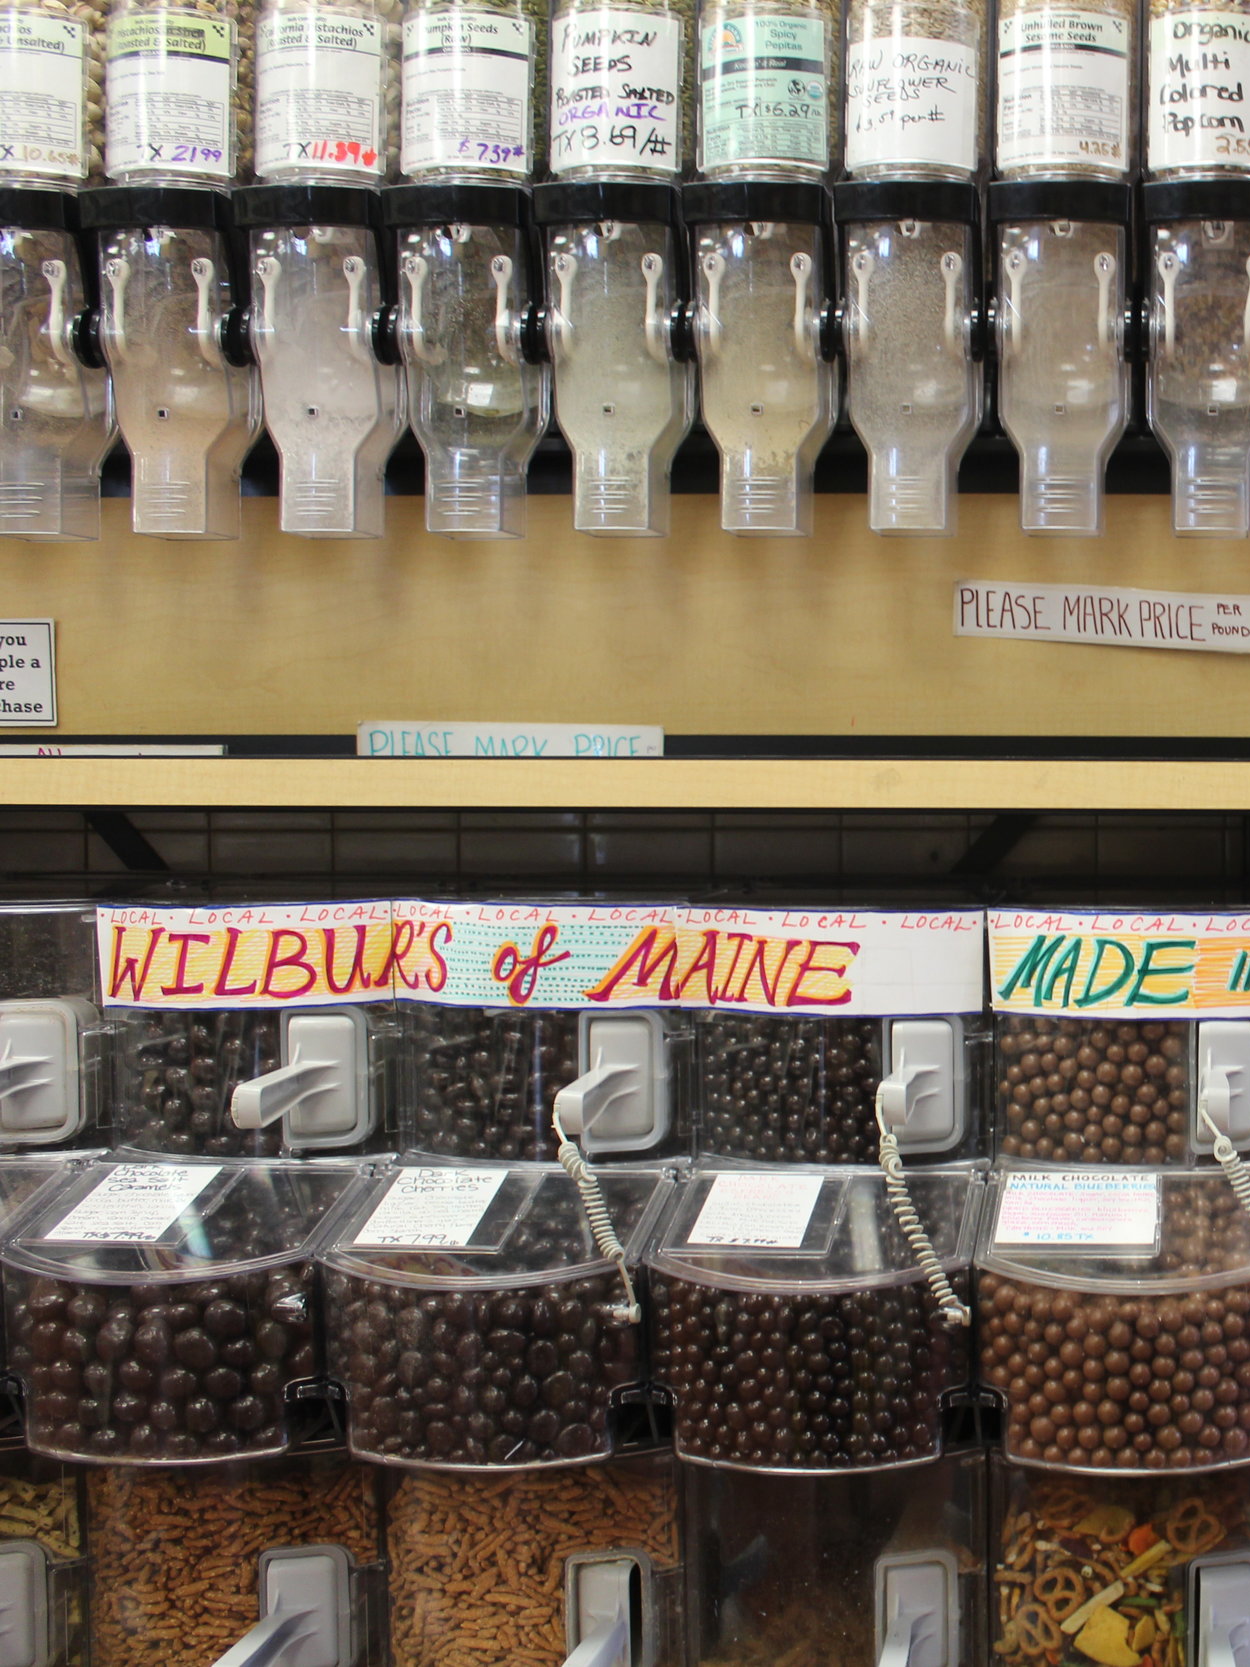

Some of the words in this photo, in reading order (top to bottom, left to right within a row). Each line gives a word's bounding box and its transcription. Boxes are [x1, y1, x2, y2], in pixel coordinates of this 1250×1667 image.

[115, 26, 160, 38] istachios
[309, 23, 364, 38] istachios
[466, 22, 499, 35] Seeds
[769, 28, 798, 41] Spicy
[1067, 20, 1104, 33] Brown
[561, 22, 658, 52] PUMPKIN
[1067, 31, 1098, 43] Seeds
[567, 55, 633, 77] SEEDS
[892, 52, 977, 79] ORGANIC
[1169, 51, 1231, 79] Multi
[558, 102, 668, 126] ORGANIC
[959, 587, 1052, 631] PLEASE
[1062, 594, 1133, 638] MARK
[1138, 599, 1208, 642] PRICE
[1216, 602, 1243, 617] PER
[30, 656, 42, 669] a
[368, 730, 455, 757] PLEASE
[110, 910, 163, 926] LOCAL
[188, 908, 274, 925] LOCAL
[299, 905, 384, 922] LOCAL
[396, 902, 454, 920] LOCAL
[477, 906, 560, 923] LOCAL
[588, 907, 676, 923] LOCAL
[686, 908, 758, 926] LOCAL
[781, 911, 868, 929] LOCAL
[900, 914, 972, 931] LOCAL
[993, 913, 1073, 931] LOCAL
[1090, 913, 1178, 931] LOCAL
[108, 920, 453, 1004] WILBUR'S
[491, 921, 571, 1006] of
[581, 923, 862, 1008] MAINE
[996, 934, 1197, 1008] MADE
[1009, 1182, 1066, 1191] NATURAL
[1012, 1174, 1052, 1182] MILK
[1061, 1174, 1150, 1183] CHOCOLATE
